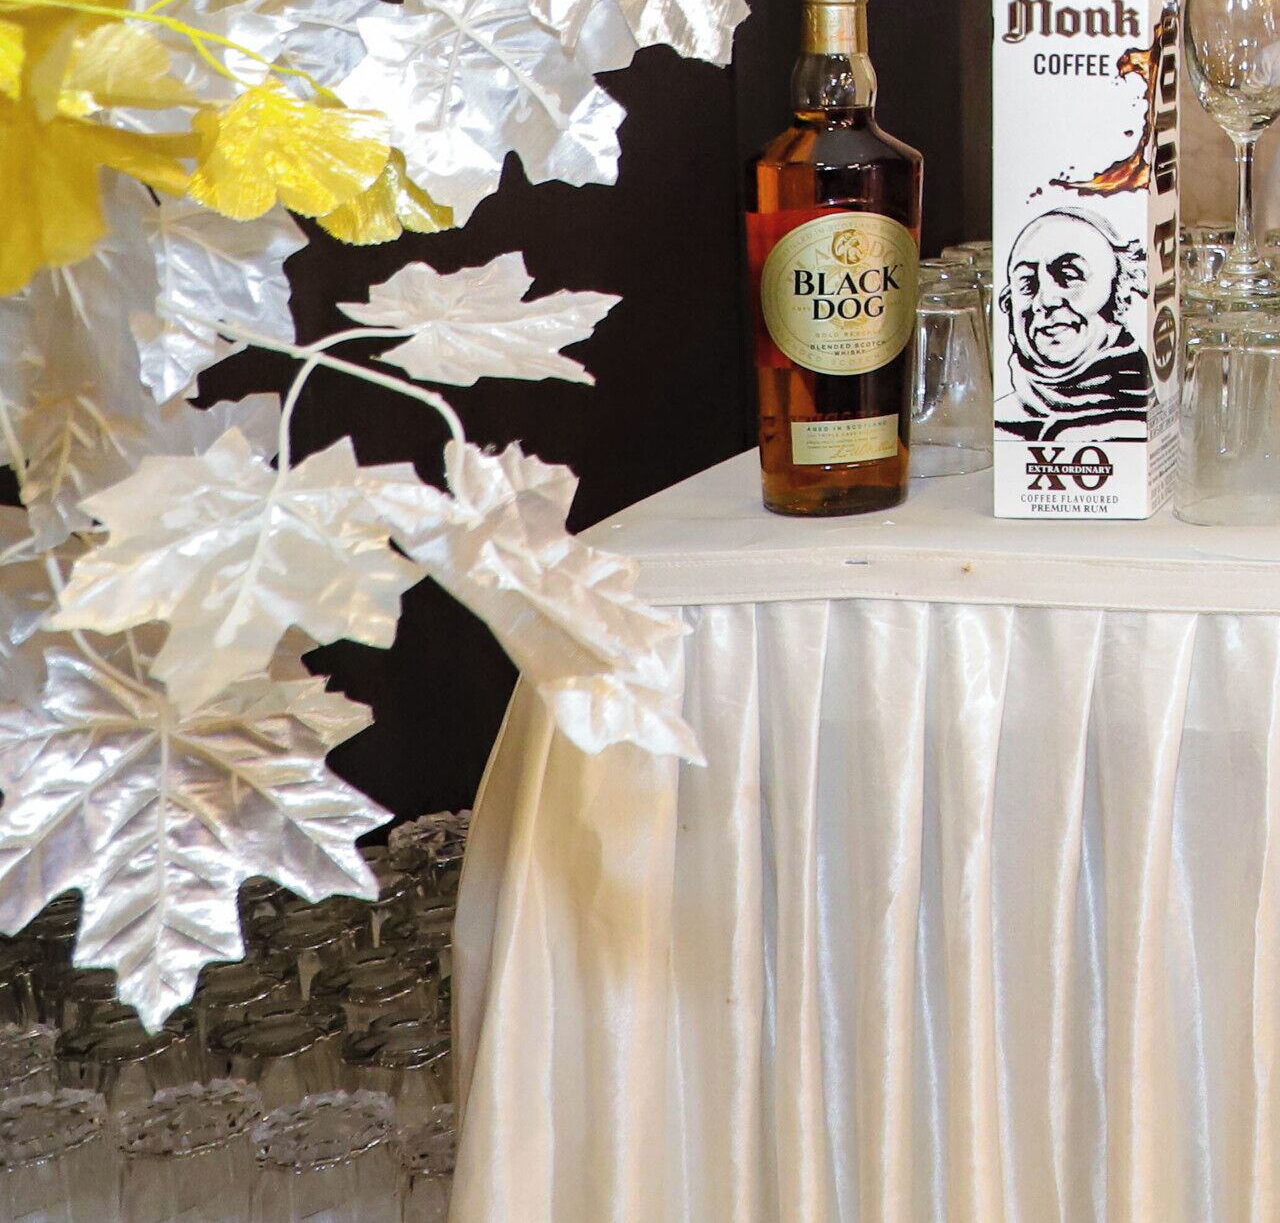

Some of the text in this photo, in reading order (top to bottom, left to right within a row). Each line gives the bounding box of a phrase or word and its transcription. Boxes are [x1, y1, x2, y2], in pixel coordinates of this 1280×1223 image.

[1034, 53, 1110, 76] COFFEE
[794, 264, 900, 296] BLACK
[813, 295, 885, 320] DOG
[1152, 212, 1177, 382] Old
[810, 343, 851, 351] BLENDED
[1027, 446, 1110, 491] XO
[1028, 465, 1112, 475] EXTRA ORDINARY
[1020, 494, 1119, 504] COFFEE FLAVOURED
[1031, 504, 1108, 513] PREMIUM RUM
